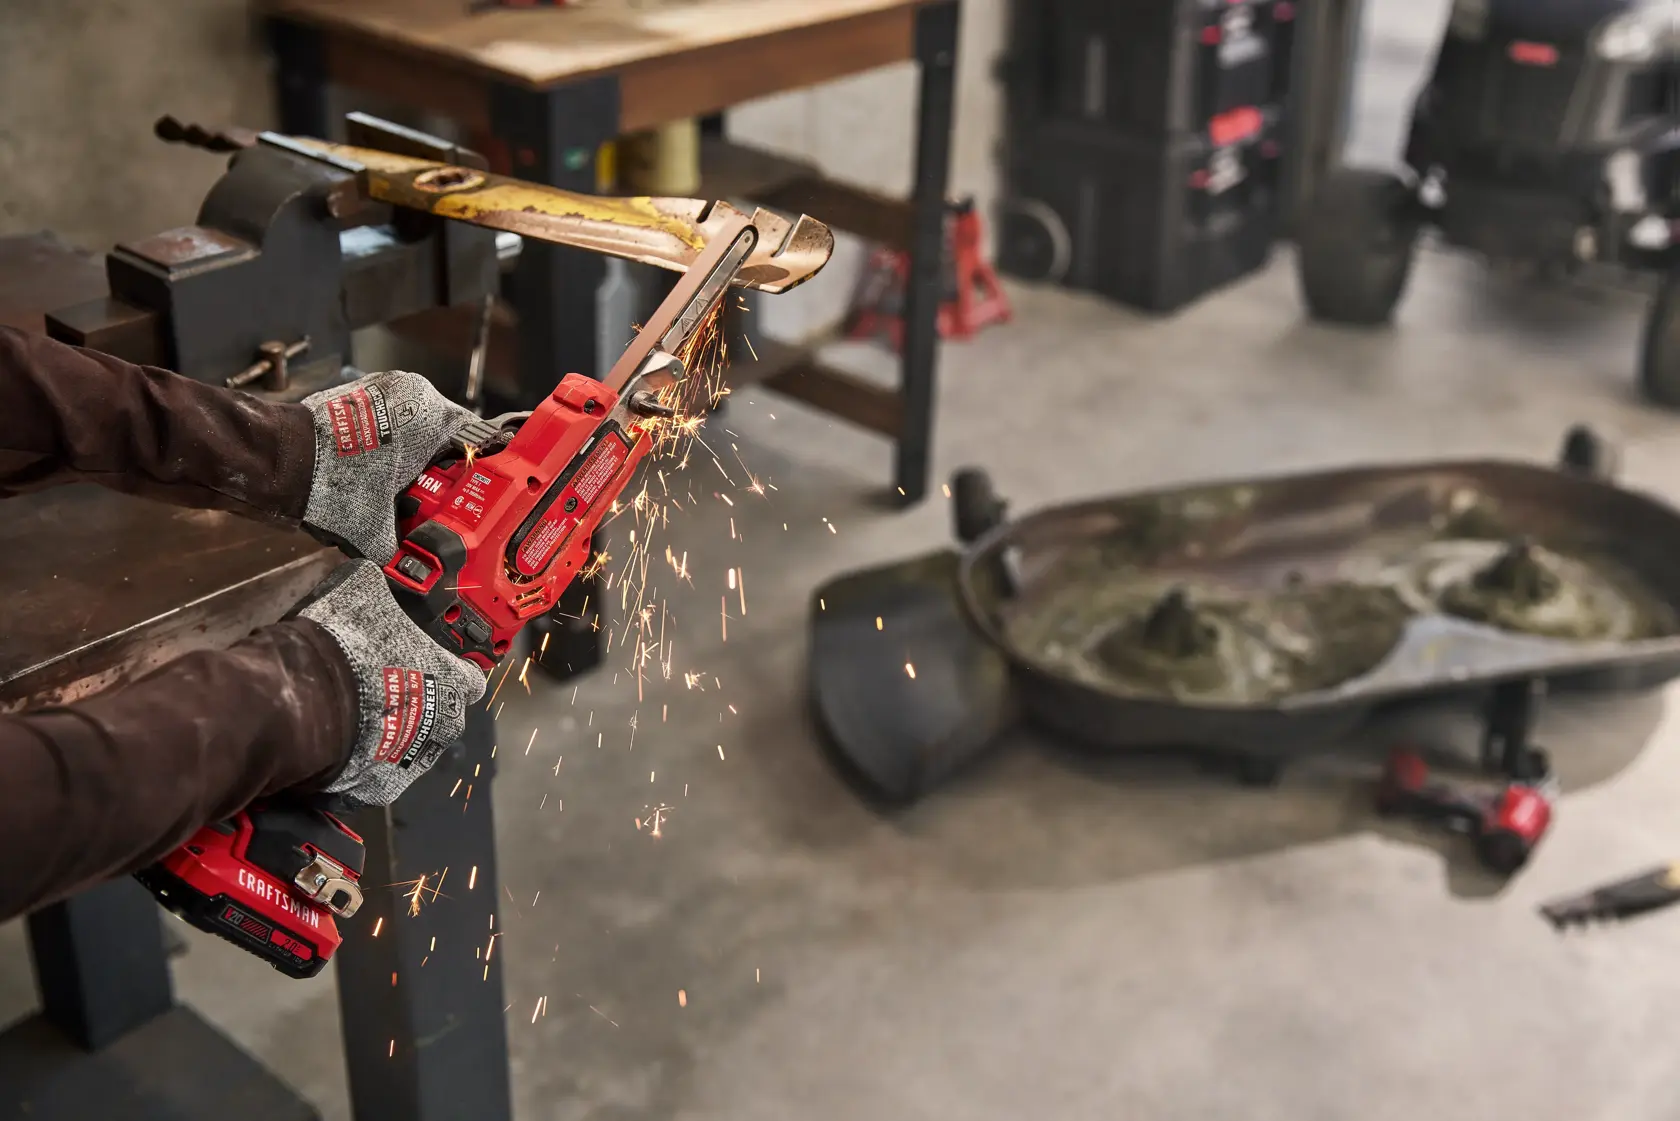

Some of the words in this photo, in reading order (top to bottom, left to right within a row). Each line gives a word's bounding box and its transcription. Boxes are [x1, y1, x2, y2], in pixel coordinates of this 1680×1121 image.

[410, 673, 418, 689] S/M
[404, 679, 435, 762] TOUCHSCREEN
[448, 691, 457, 713] A2
[238, 868, 319, 929] CRAFTSMAN
